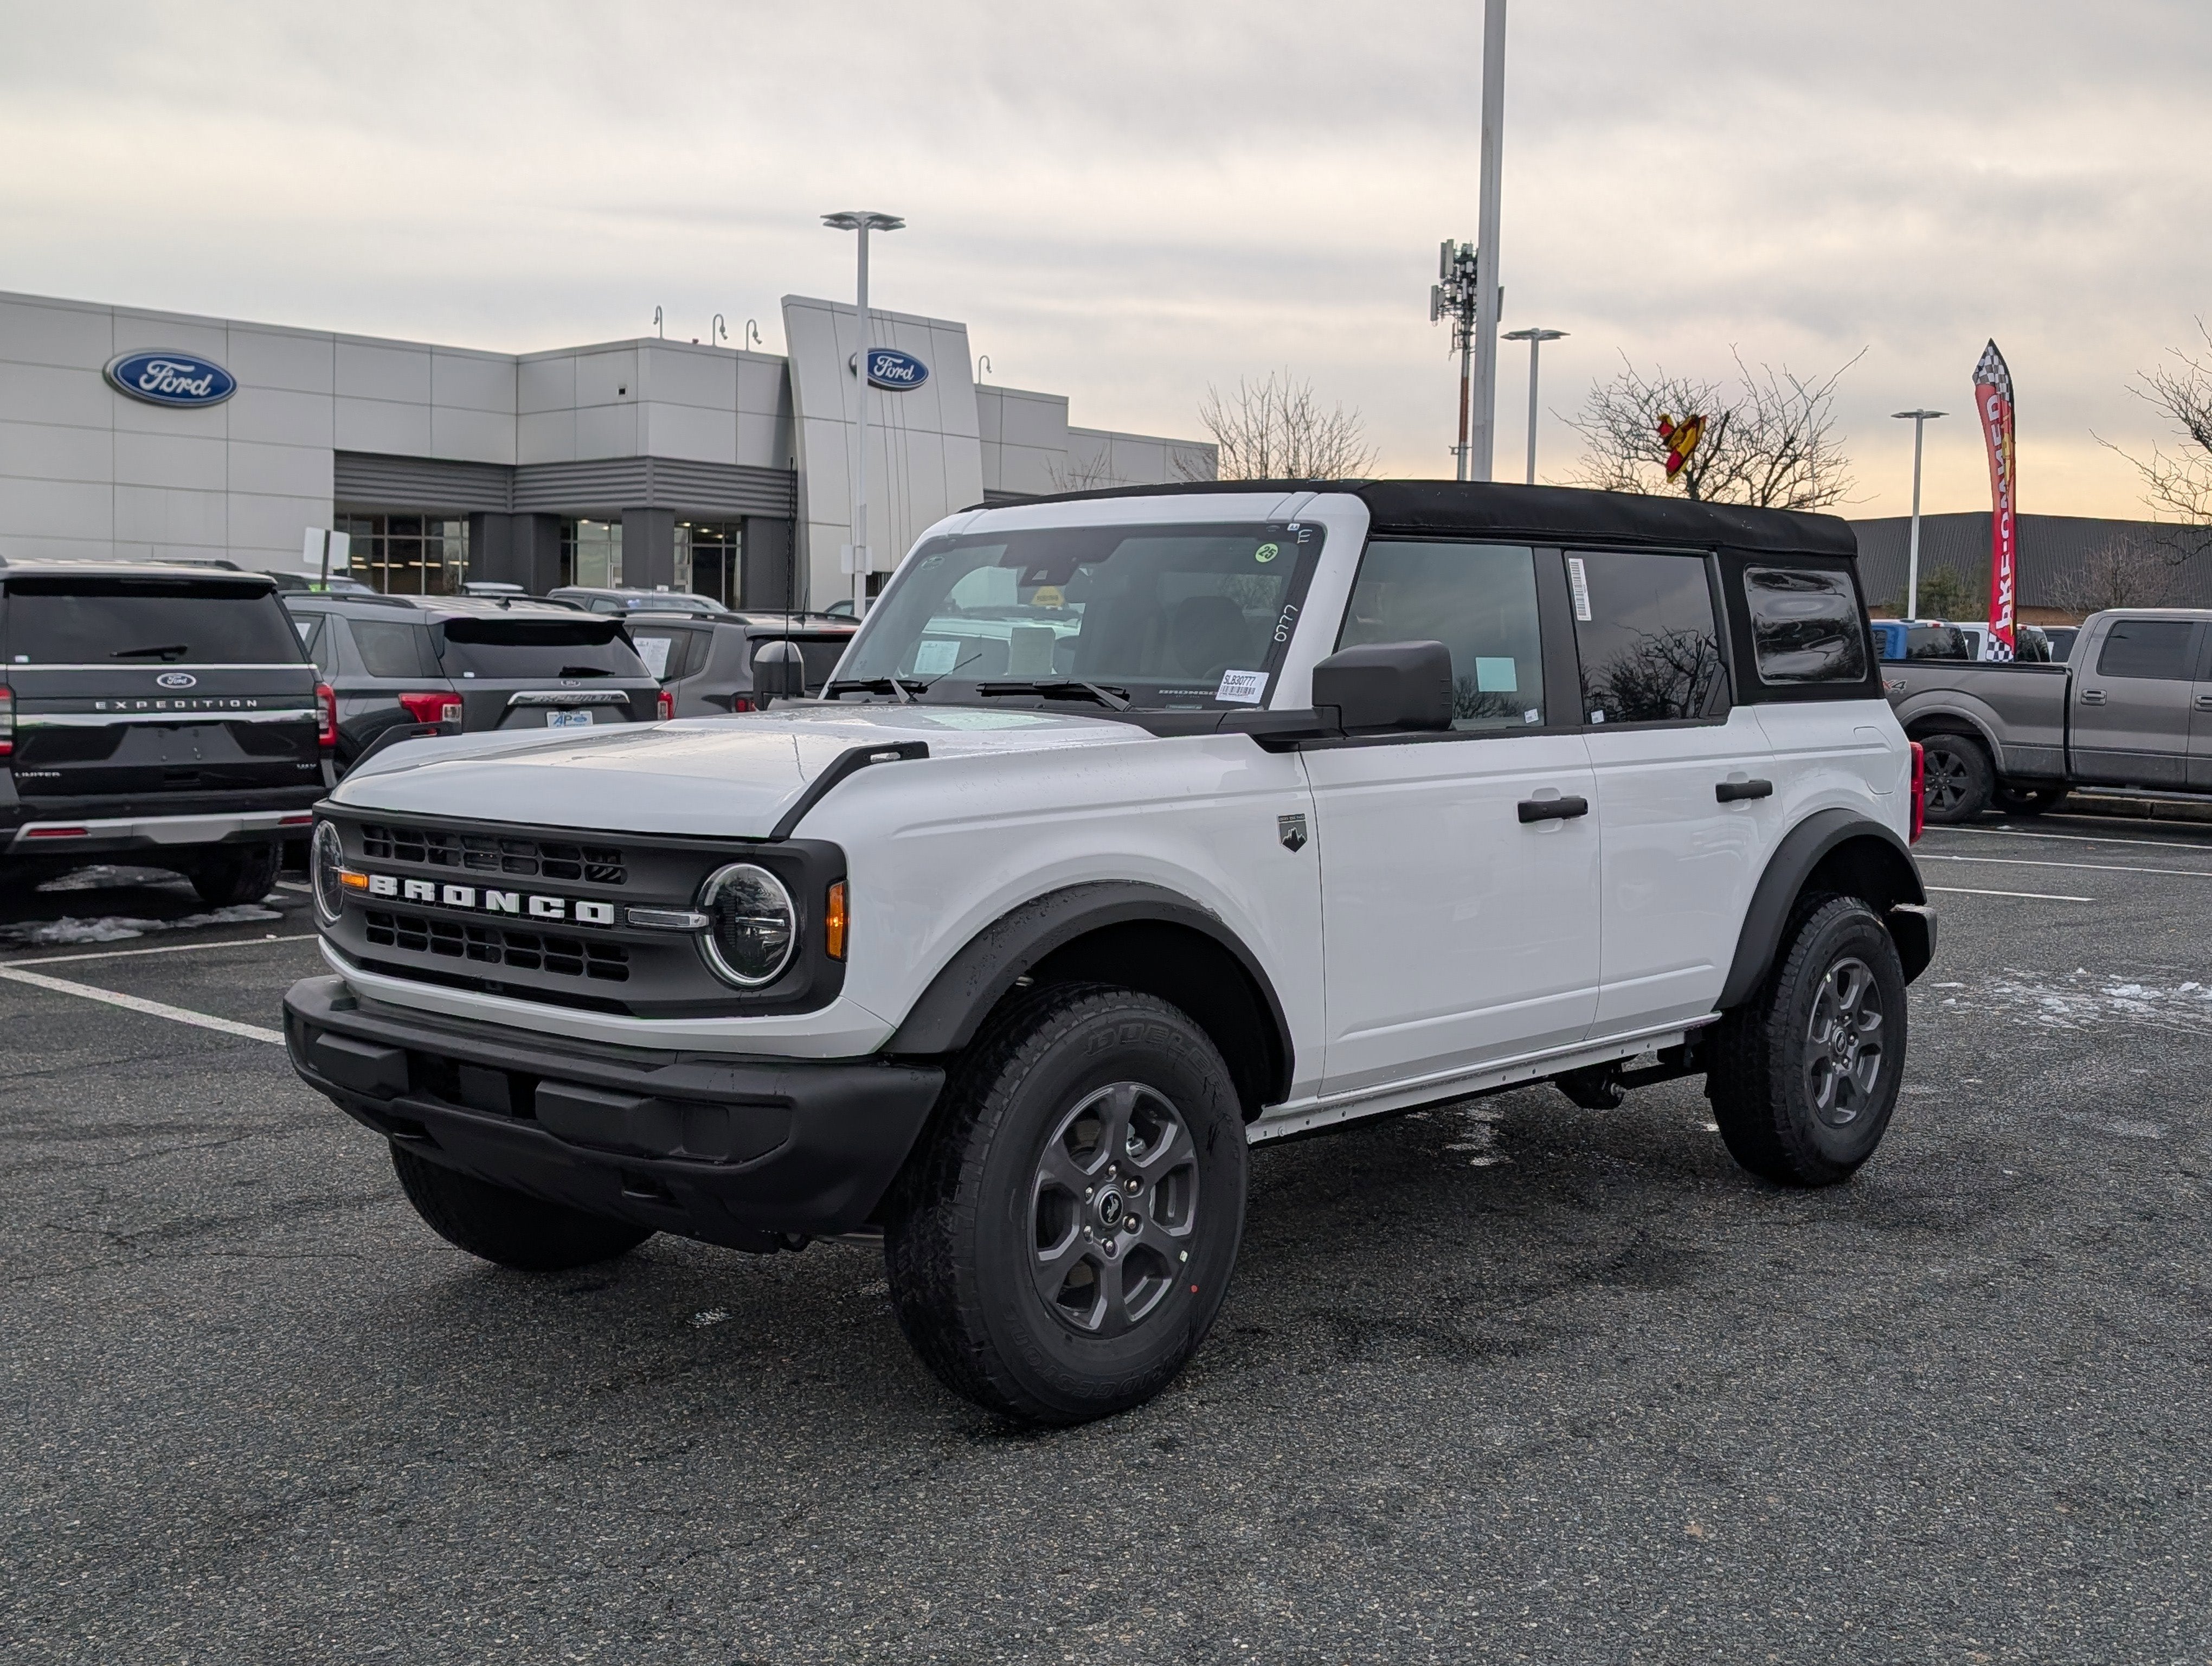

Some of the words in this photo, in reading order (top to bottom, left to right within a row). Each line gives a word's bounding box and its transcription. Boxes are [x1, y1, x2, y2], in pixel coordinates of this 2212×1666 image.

[139, 360, 213, 396] Ford
[873, 355, 915, 381] Ford
[1258, 546, 1276, 559] 25
[1274, 604, 1298, 642] 0777
[1223, 674, 1256, 687] SLB30777
[95, 699, 258, 710] EXPEDITION
[369, 874, 614, 924] BRONCO
